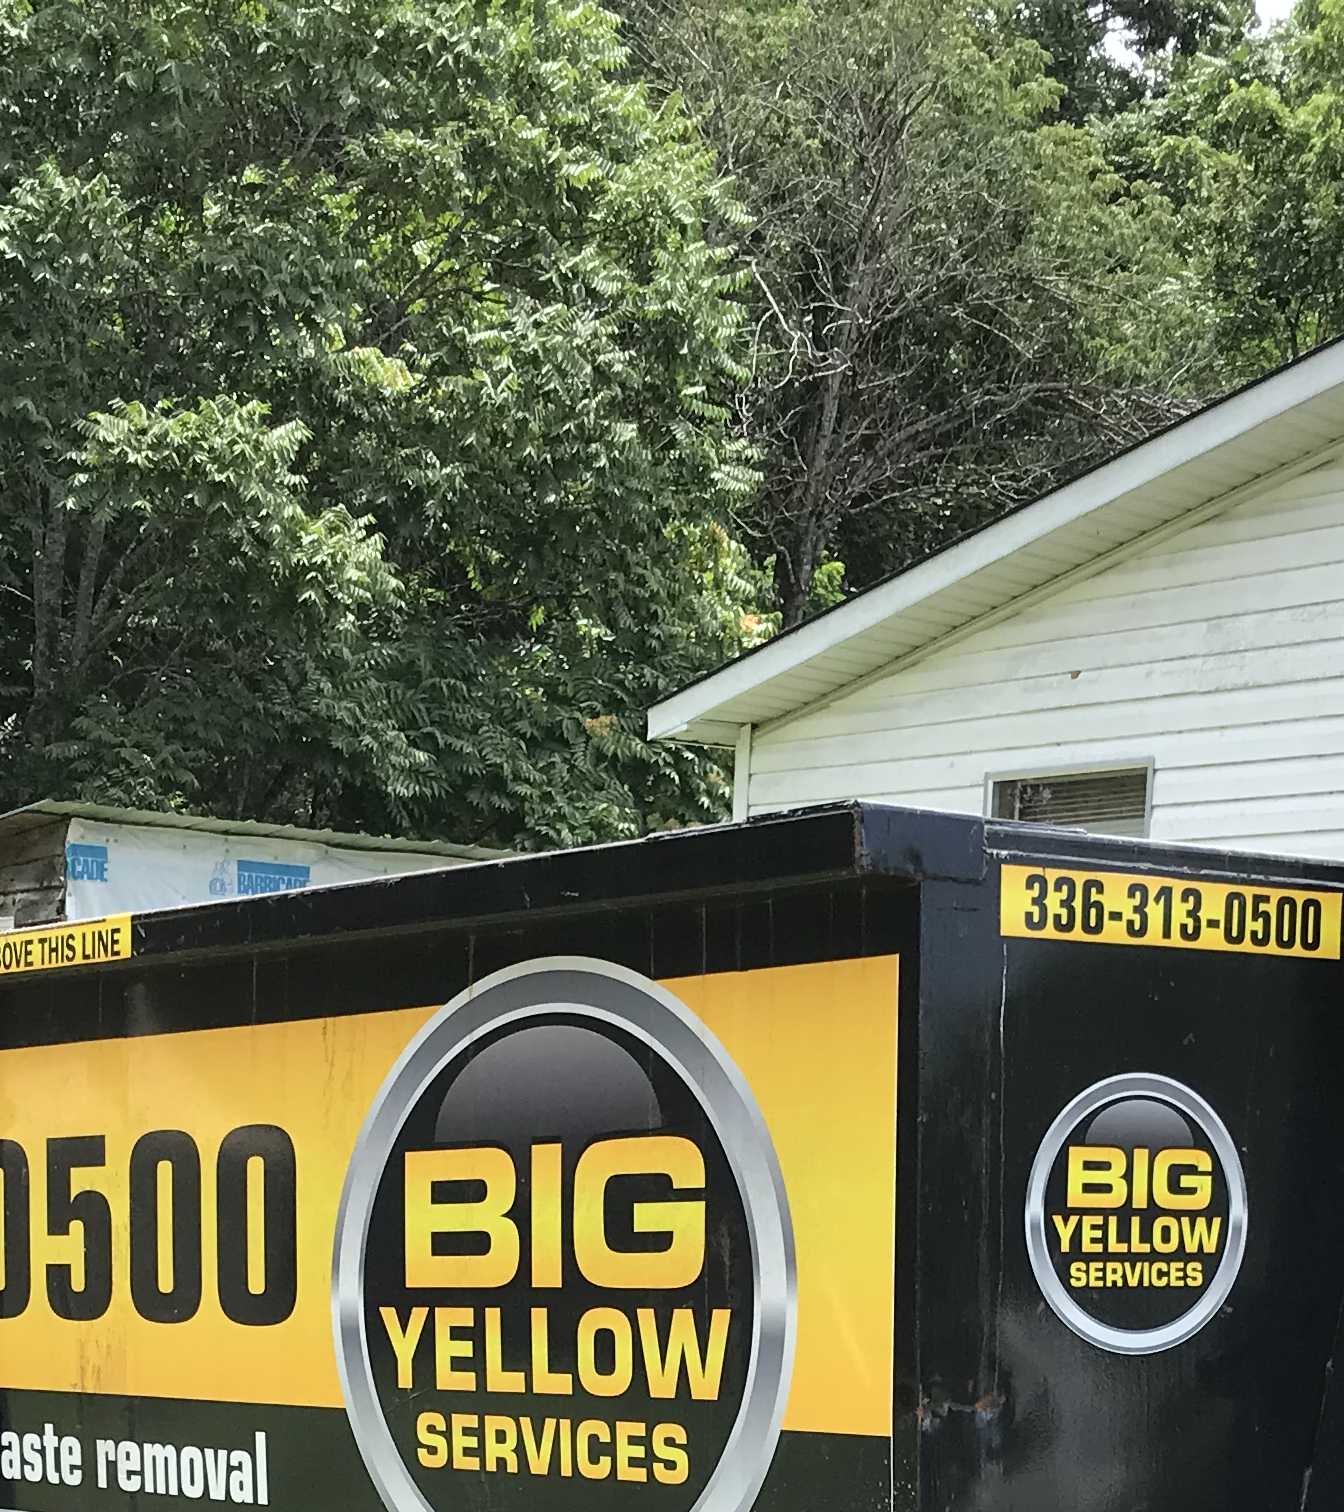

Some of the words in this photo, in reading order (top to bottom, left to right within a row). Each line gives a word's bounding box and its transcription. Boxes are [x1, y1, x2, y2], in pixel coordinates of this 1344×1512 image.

[37, 933, 76, 965] THIS
[82, 928, 121, 960] LINE
[1024, 873, 1322, 952] 336-313-0500
[404, 1135, 706, 1289] BIG
[1066, 1145, 1213, 1211] BIG
[1052, 1214, 1222, 1254] YELLOW
[1069, 1261, 1204, 1288] SERVICES
[378, 1306, 732, 1401] YELLOW
[96, 1431, 269, 1506] removal
[416, 1411, 690, 1485] SERVICES
